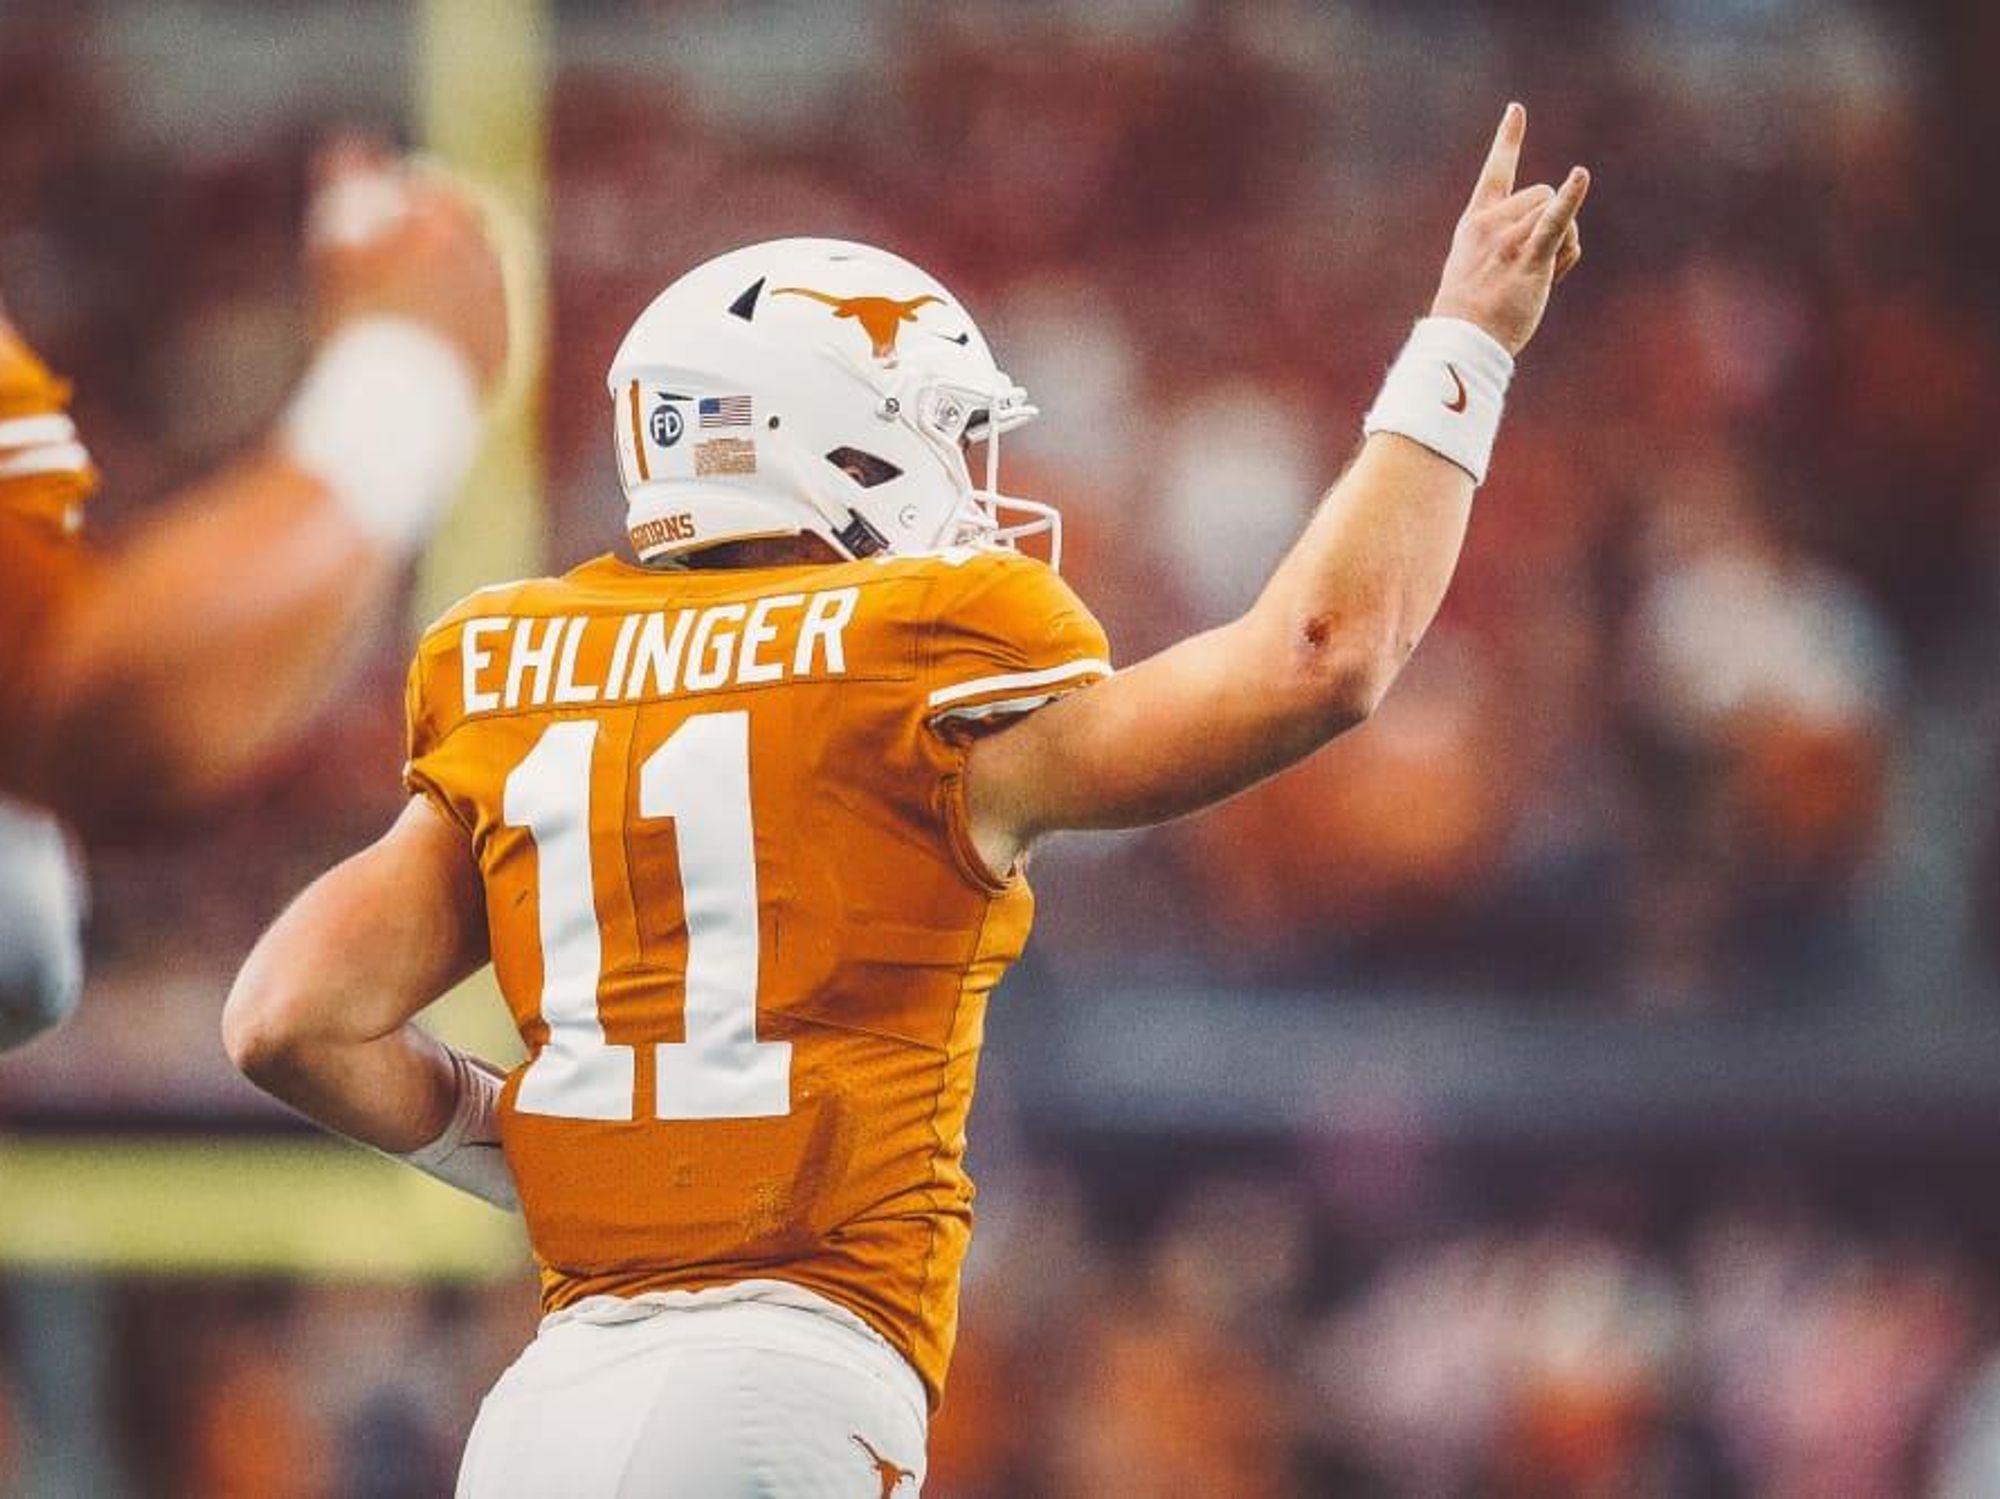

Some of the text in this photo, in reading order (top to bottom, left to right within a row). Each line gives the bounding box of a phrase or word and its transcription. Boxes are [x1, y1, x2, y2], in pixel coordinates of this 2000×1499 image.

[654, 411, 682, 439] FD
[463, 587, 859, 714] EHLINGER
[503, 710, 792, 1120] 11
